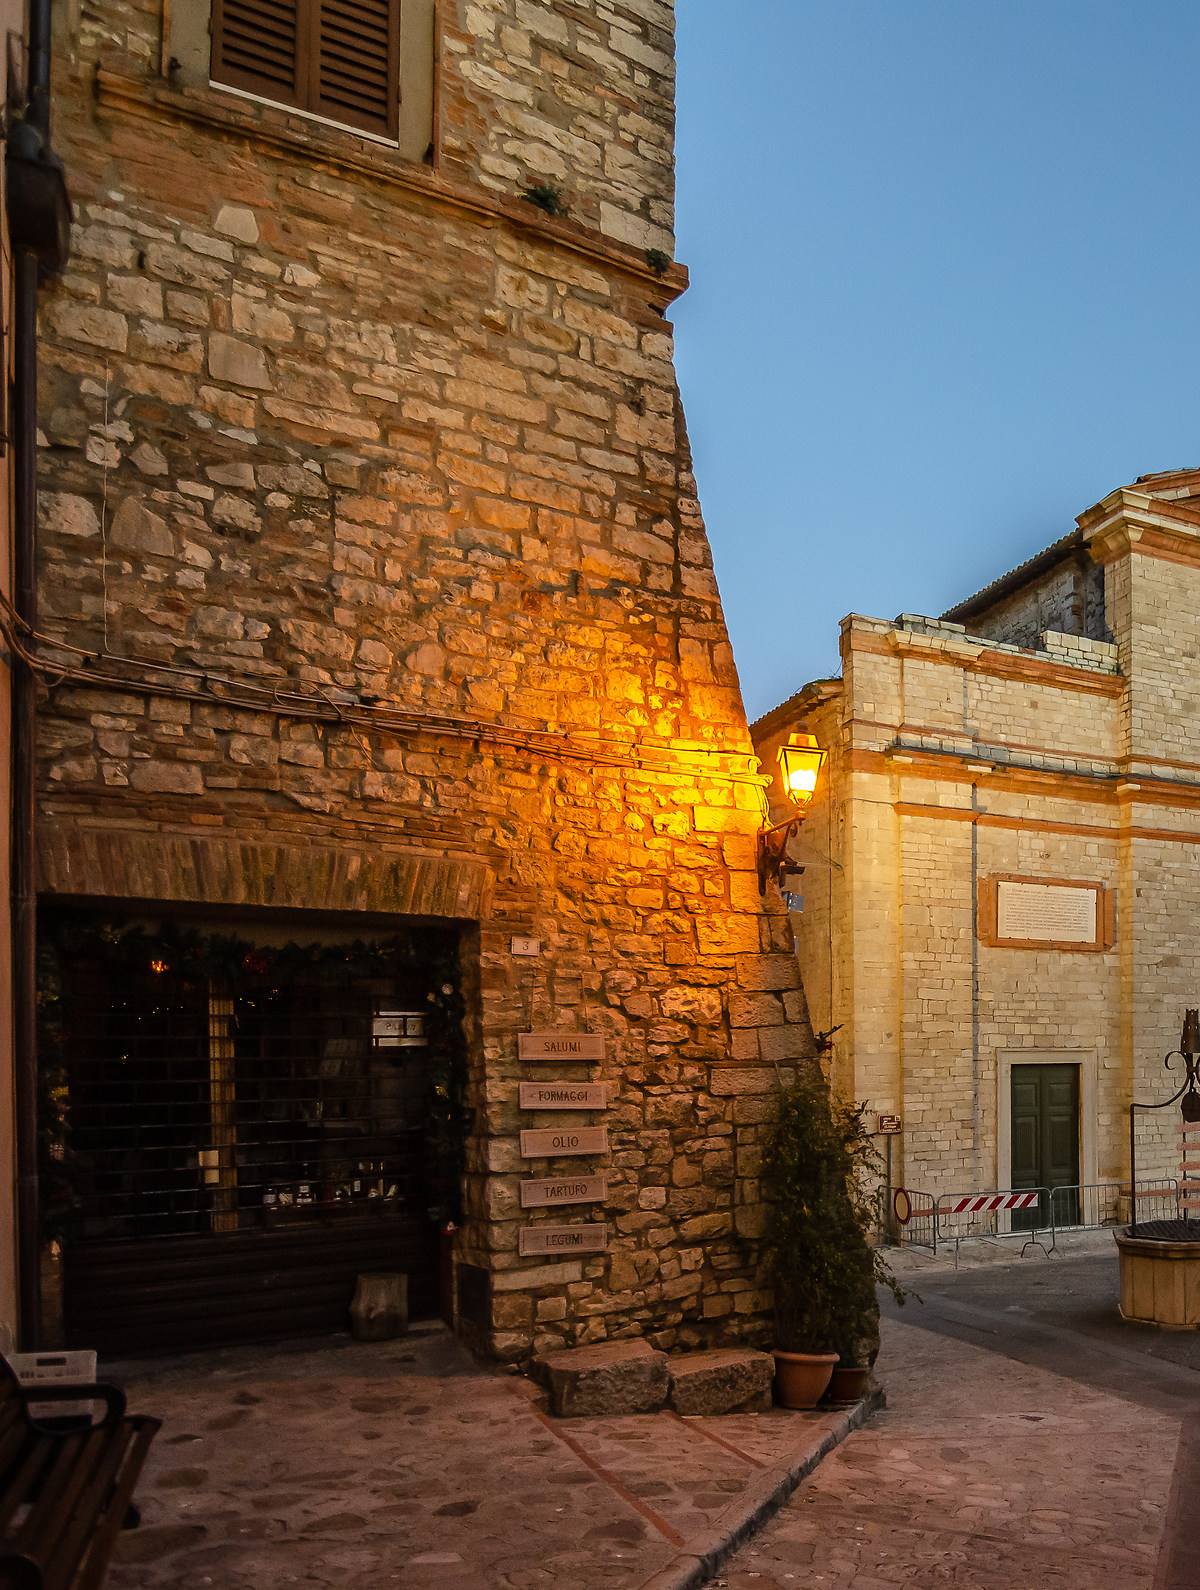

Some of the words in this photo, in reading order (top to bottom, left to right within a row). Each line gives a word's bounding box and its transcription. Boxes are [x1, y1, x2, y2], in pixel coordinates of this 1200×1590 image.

[522, 940, 530, 951] 3
[543, 1040, 581, 1053] SALUMI
[538, 1089, 589, 1102] FORMAGGI
[552, 1136, 579, 1148] OLIO
[544, 1184, 588, 1198] TARTUFO
[546, 1233, 583, 1246] LEGUMI
